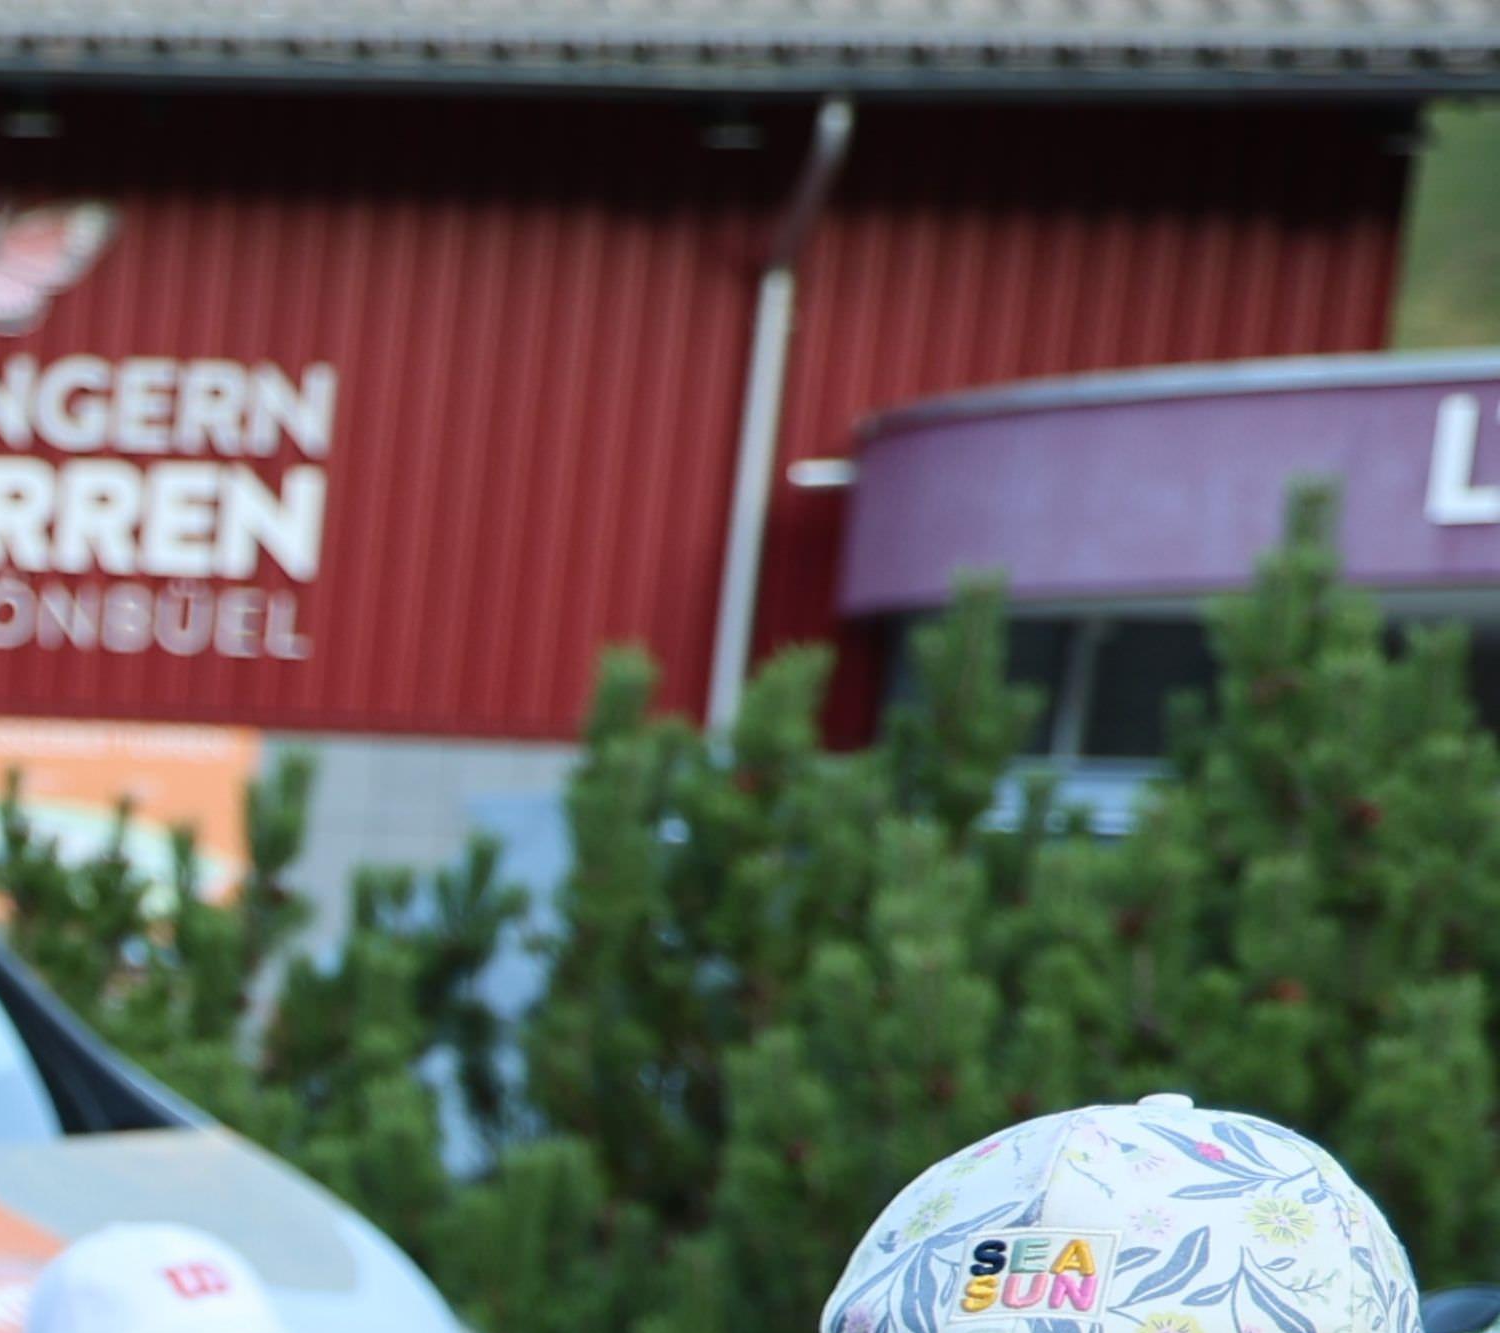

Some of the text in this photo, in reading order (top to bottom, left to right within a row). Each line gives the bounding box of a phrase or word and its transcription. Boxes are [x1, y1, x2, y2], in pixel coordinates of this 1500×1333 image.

[1425, 393, 1500, 525] L
[970, 1238, 1096, 1276] SEA
[960, 1273, 1098, 1313] SUN
